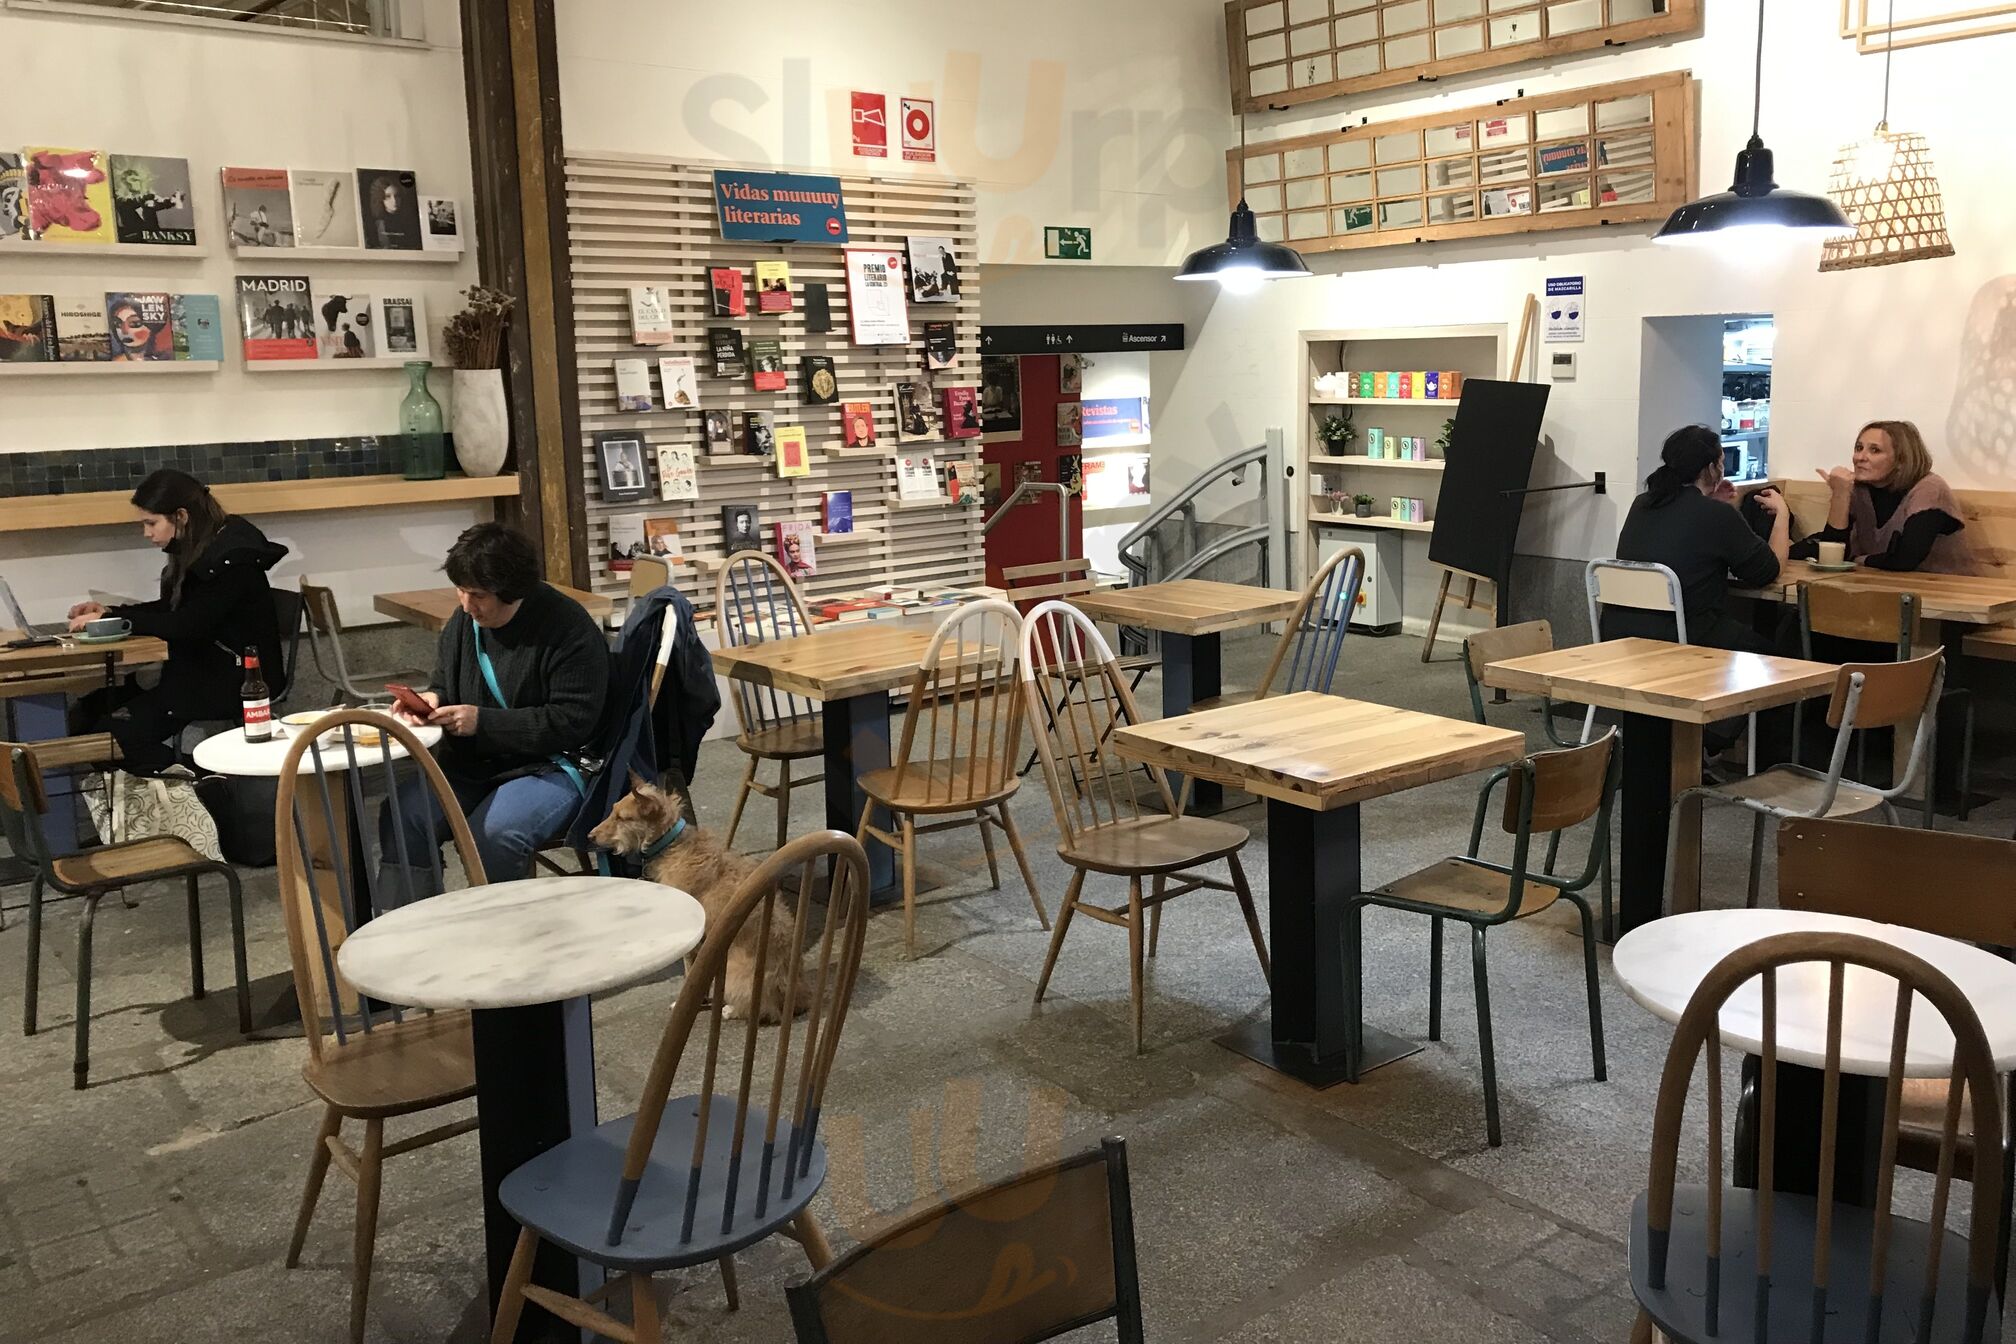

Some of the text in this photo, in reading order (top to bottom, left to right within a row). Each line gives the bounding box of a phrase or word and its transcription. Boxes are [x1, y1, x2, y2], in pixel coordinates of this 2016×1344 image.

[720, 182, 840, 209] Vidas muuuuy
[723, 205, 801, 226] literarias
[142, 229, 192, 242] BANKSY
[863, 263, 886, 273] PREMIO
[241, 279, 307, 292] MADRID
[139, 295, 164, 304] JAW
[141, 304, 164, 312] LEN
[142, 312, 165, 321] SKY
[1128, 334, 1158, 343] Ascensor
